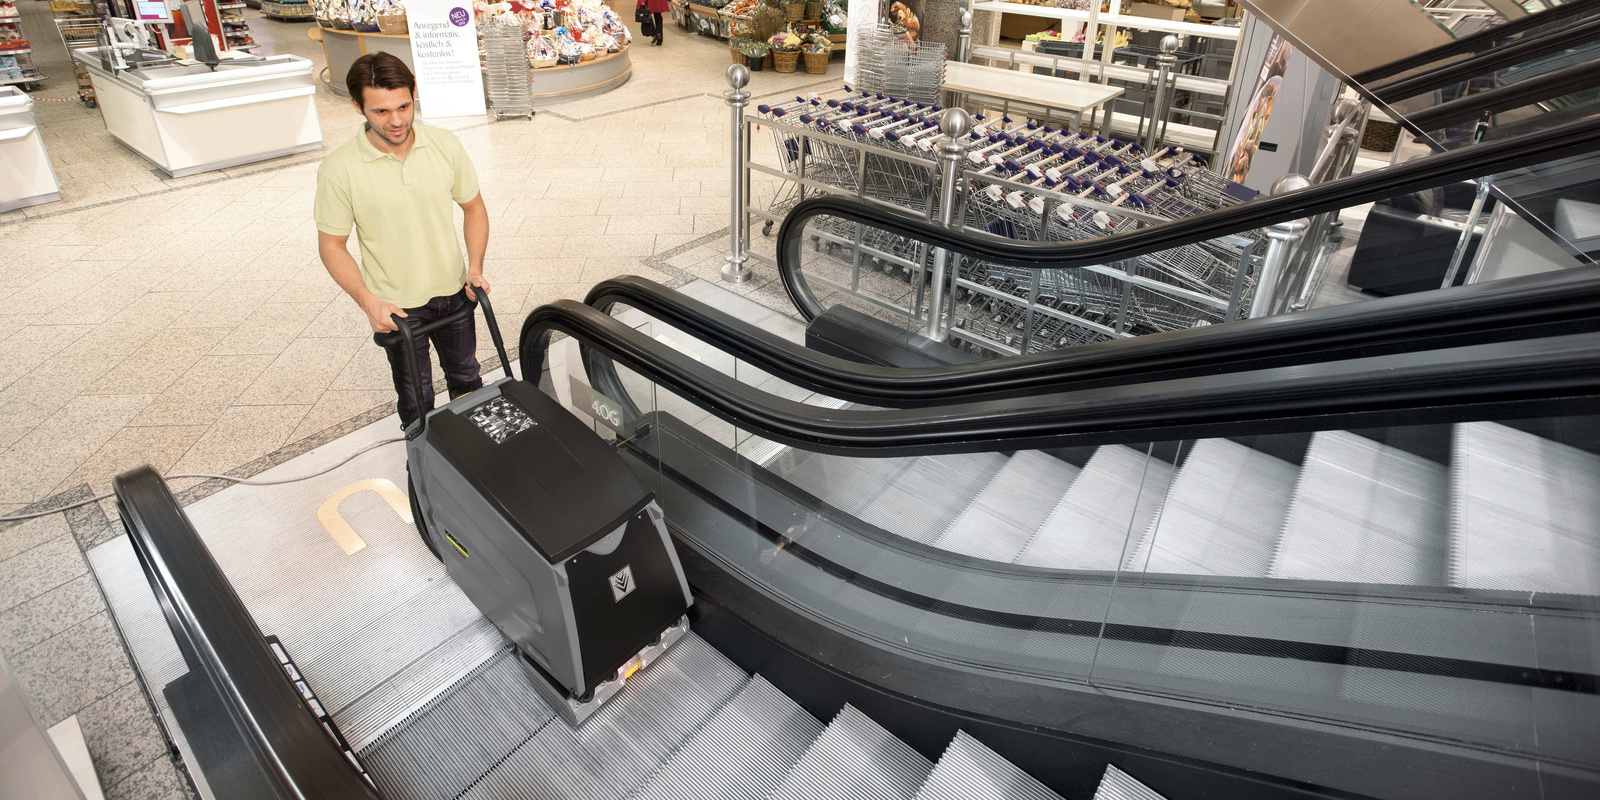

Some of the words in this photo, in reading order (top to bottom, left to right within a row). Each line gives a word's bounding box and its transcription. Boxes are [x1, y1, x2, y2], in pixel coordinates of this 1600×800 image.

[451, 10, 466, 20] NEU
[414, 21, 450, 31] Anregend
[423, 30, 461, 39] informativ,
[416, 40, 444, 49] köstlich
[446, 40, 452, 48] &
[417, 49, 455, 58] kostenlos!
